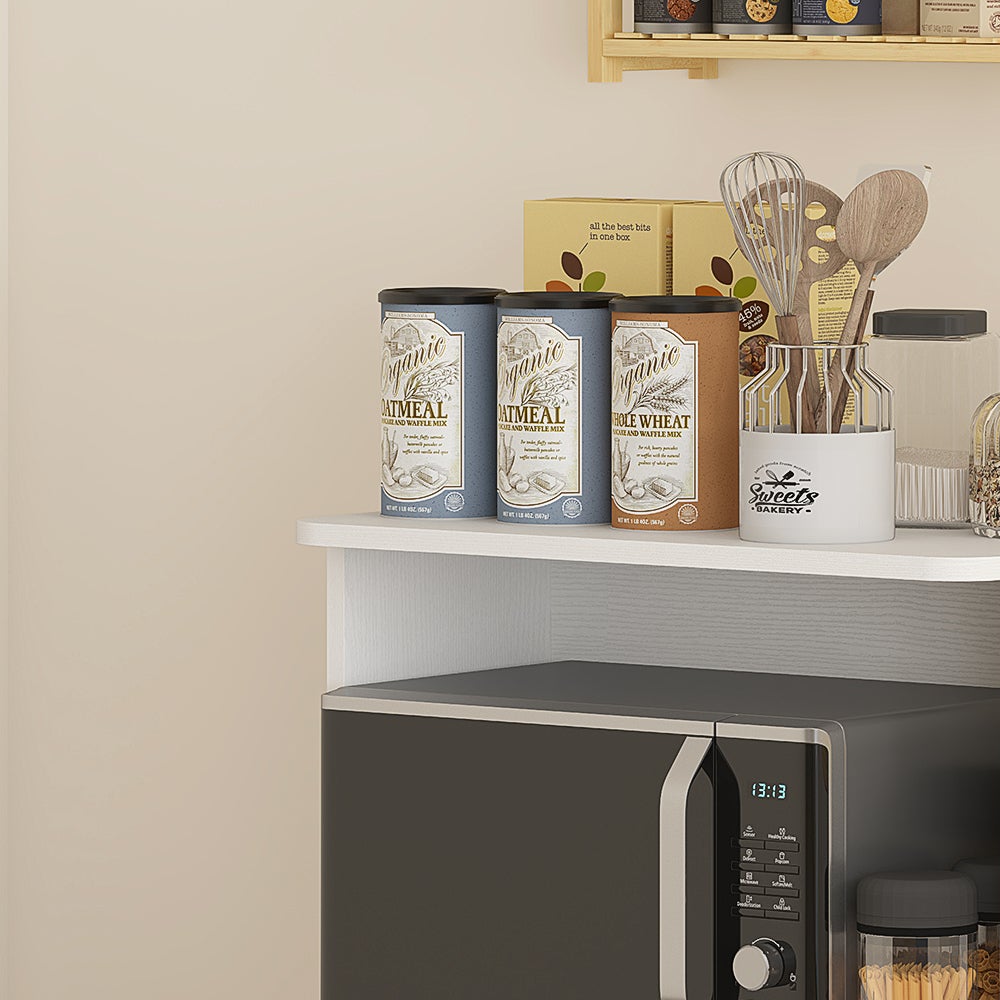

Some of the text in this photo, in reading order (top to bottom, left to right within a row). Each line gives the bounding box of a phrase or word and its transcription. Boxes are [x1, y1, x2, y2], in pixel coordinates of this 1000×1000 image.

[617, 223, 634, 231] best
[636, 224, 651, 232] bits
[616, 233, 631, 241] box
[739, 303, 761, 322] 45%
[639, 415, 691, 429] WHEAT
[749, 483, 819, 504] Sweets
[752, 783, 786, 799] 13:13
